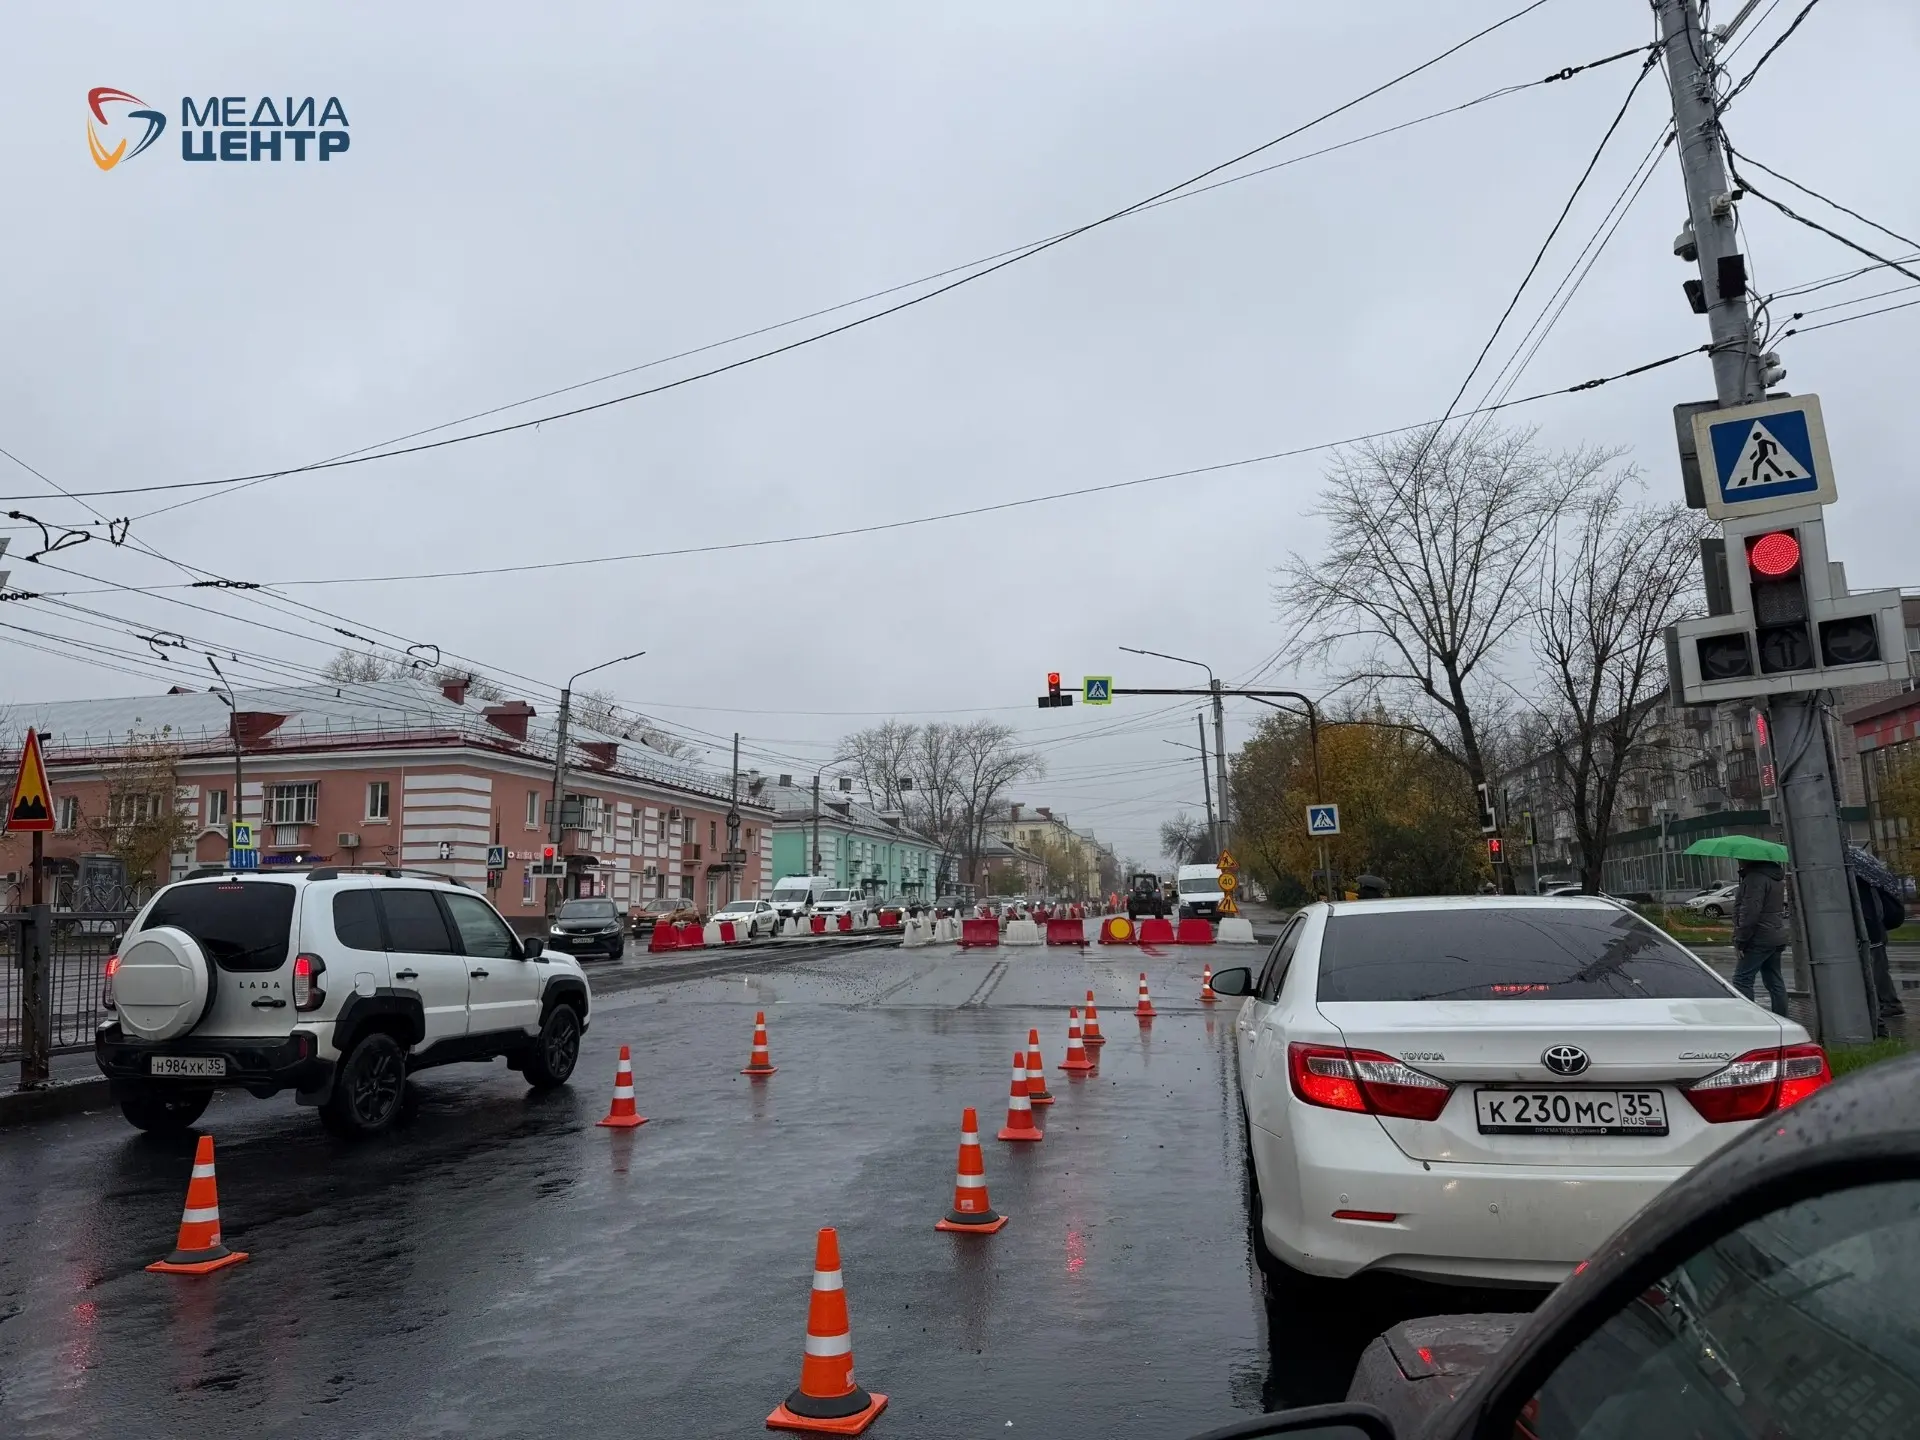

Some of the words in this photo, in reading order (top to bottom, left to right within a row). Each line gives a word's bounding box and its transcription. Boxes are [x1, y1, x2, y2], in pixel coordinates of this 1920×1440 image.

[1222, 878, 1233, 886] 40
[239, 981, 281, 989] LADA
[1400, 1051, 1446, 1061] TOYOTA
[207, 1058, 221, 1071] 35
[1489, 1094, 1616, 1124] К230МС
[1622, 1094, 1653, 1117] 35
[1622, 1116, 1646, 1126] RUS
